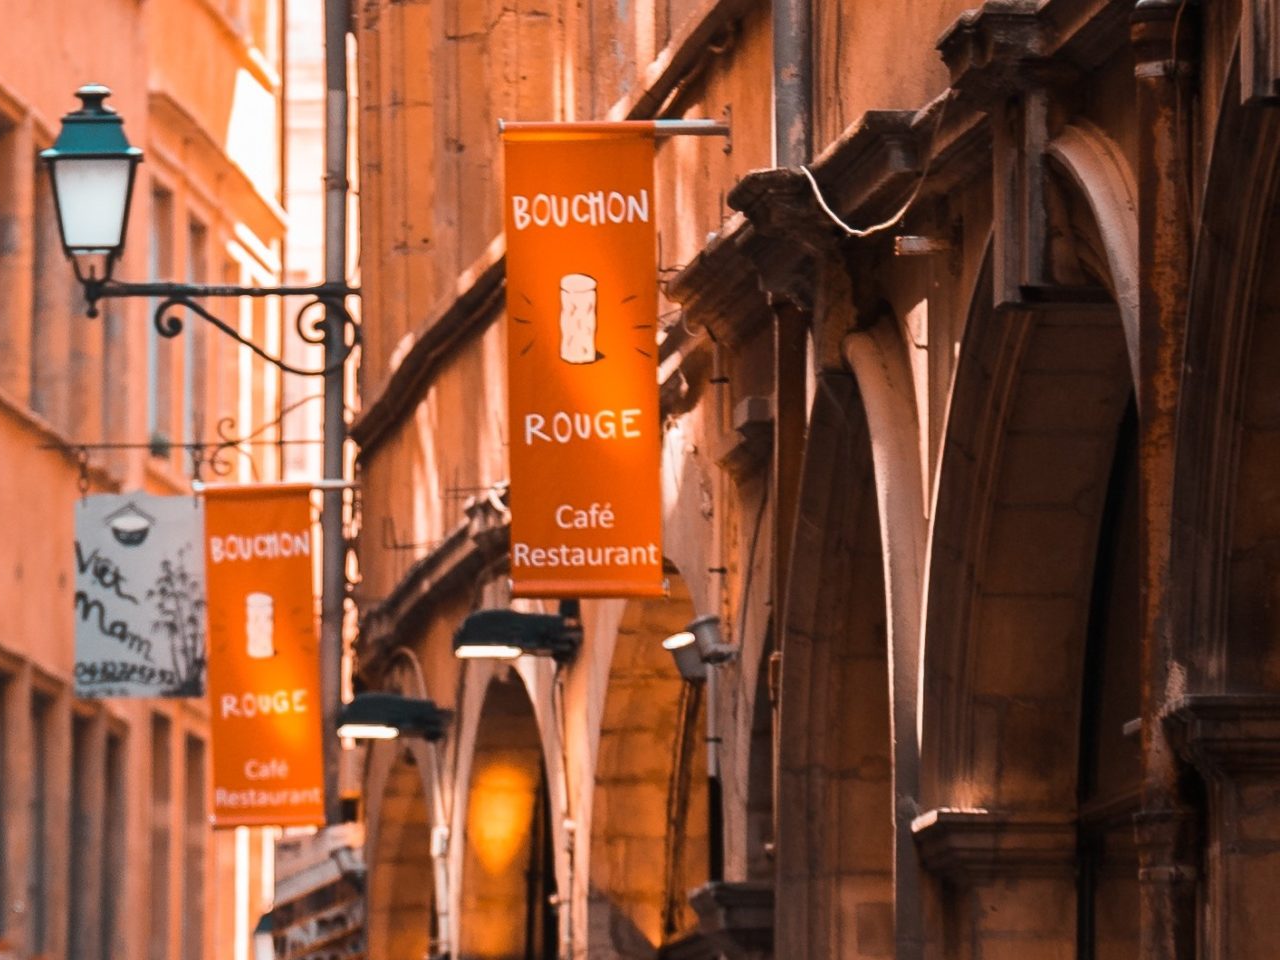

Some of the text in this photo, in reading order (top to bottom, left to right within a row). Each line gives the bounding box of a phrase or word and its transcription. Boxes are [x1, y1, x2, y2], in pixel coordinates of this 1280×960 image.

[513, 190, 649, 230] BOUCHON
[524, 408, 642, 446] ROUGE
[555, 502, 615, 529] Café
[209, 530, 310, 564] BOUCHON
[513, 543, 659, 568] Restaurant
[222, 690, 308, 719] ROUGE
[244, 759, 288, 781] Café
[215, 786, 320, 808] Restaurant
